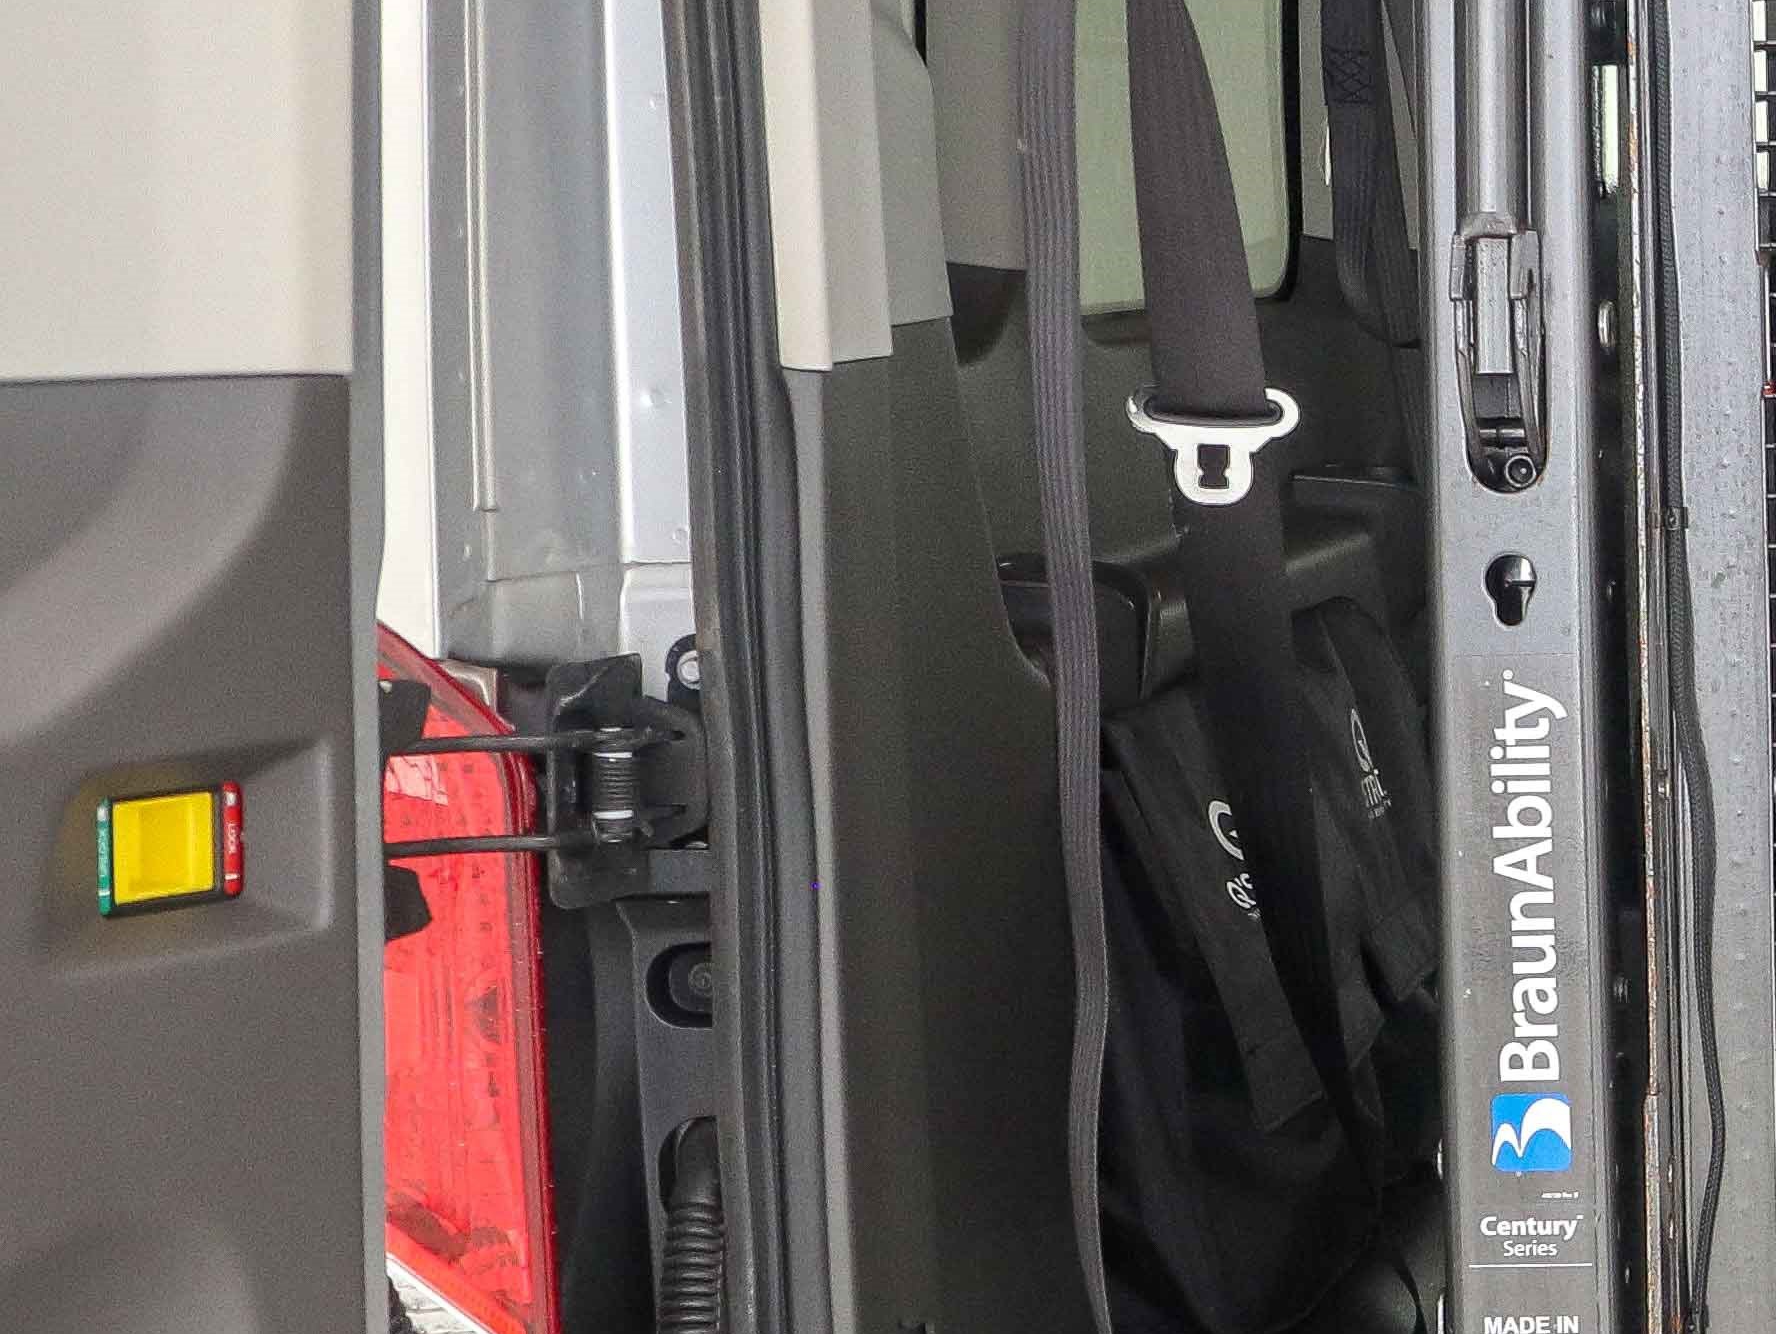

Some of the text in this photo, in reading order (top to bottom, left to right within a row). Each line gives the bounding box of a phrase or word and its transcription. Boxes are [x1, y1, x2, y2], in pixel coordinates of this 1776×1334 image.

[1489, 668, 1568, 1084] BraunAbility
[1480, 1216, 1582, 1241] Century
[1503, 1240, 1558, 1257] Series
[1484, 1315, 1579, 1334] MADE IN
